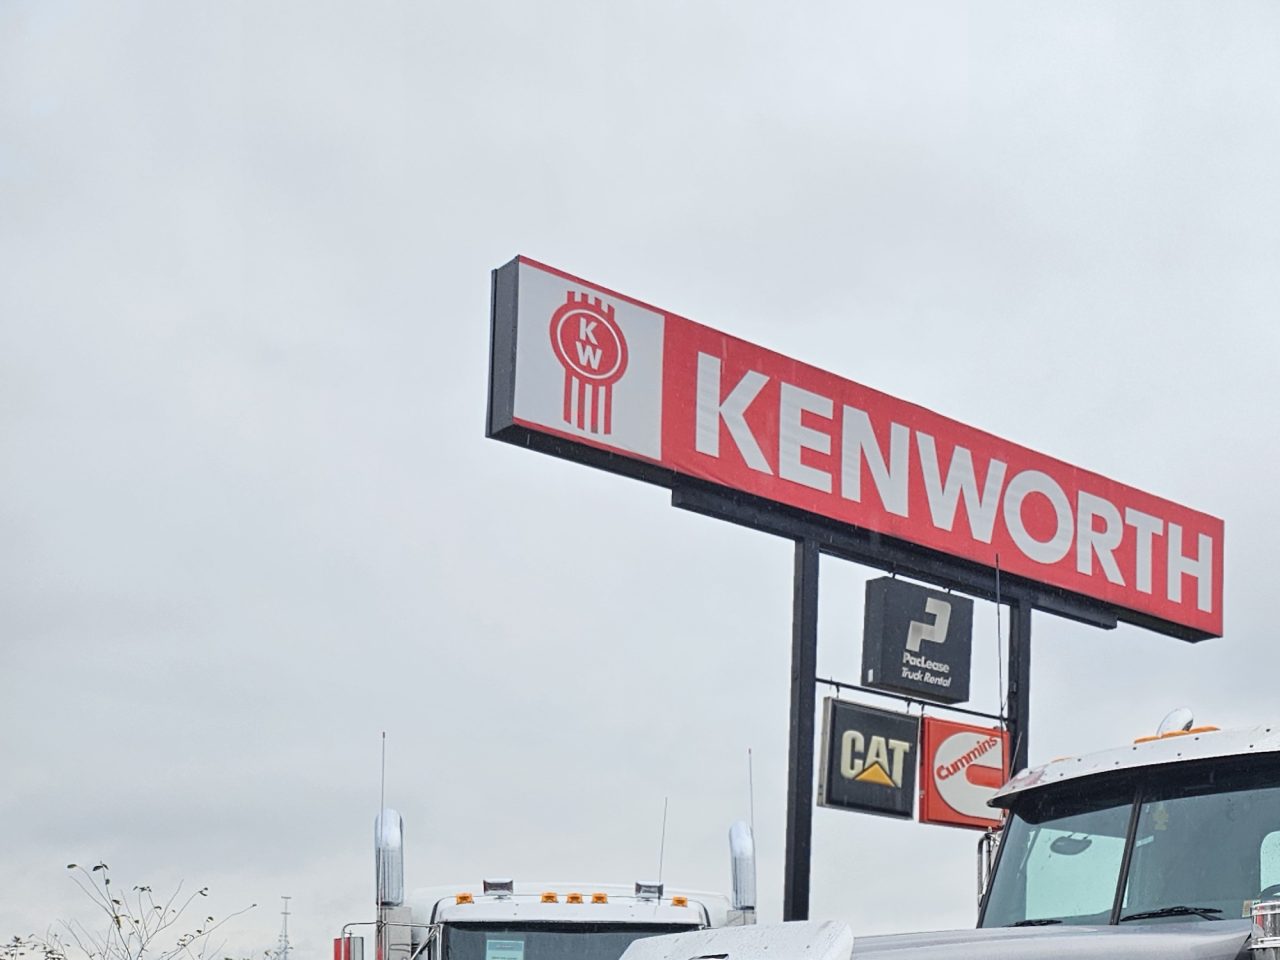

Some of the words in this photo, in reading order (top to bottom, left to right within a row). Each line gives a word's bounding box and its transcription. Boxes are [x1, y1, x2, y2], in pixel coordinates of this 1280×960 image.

[695, 351, 1213, 614] KENWORTH
[901, 667, 924, 681] Truck
[923, 672, 952, 687] Rental
[902, 652, 950, 673] PacLease
[840, 730, 911, 788] CAT
[936, 736, 998, 781] Cummins
